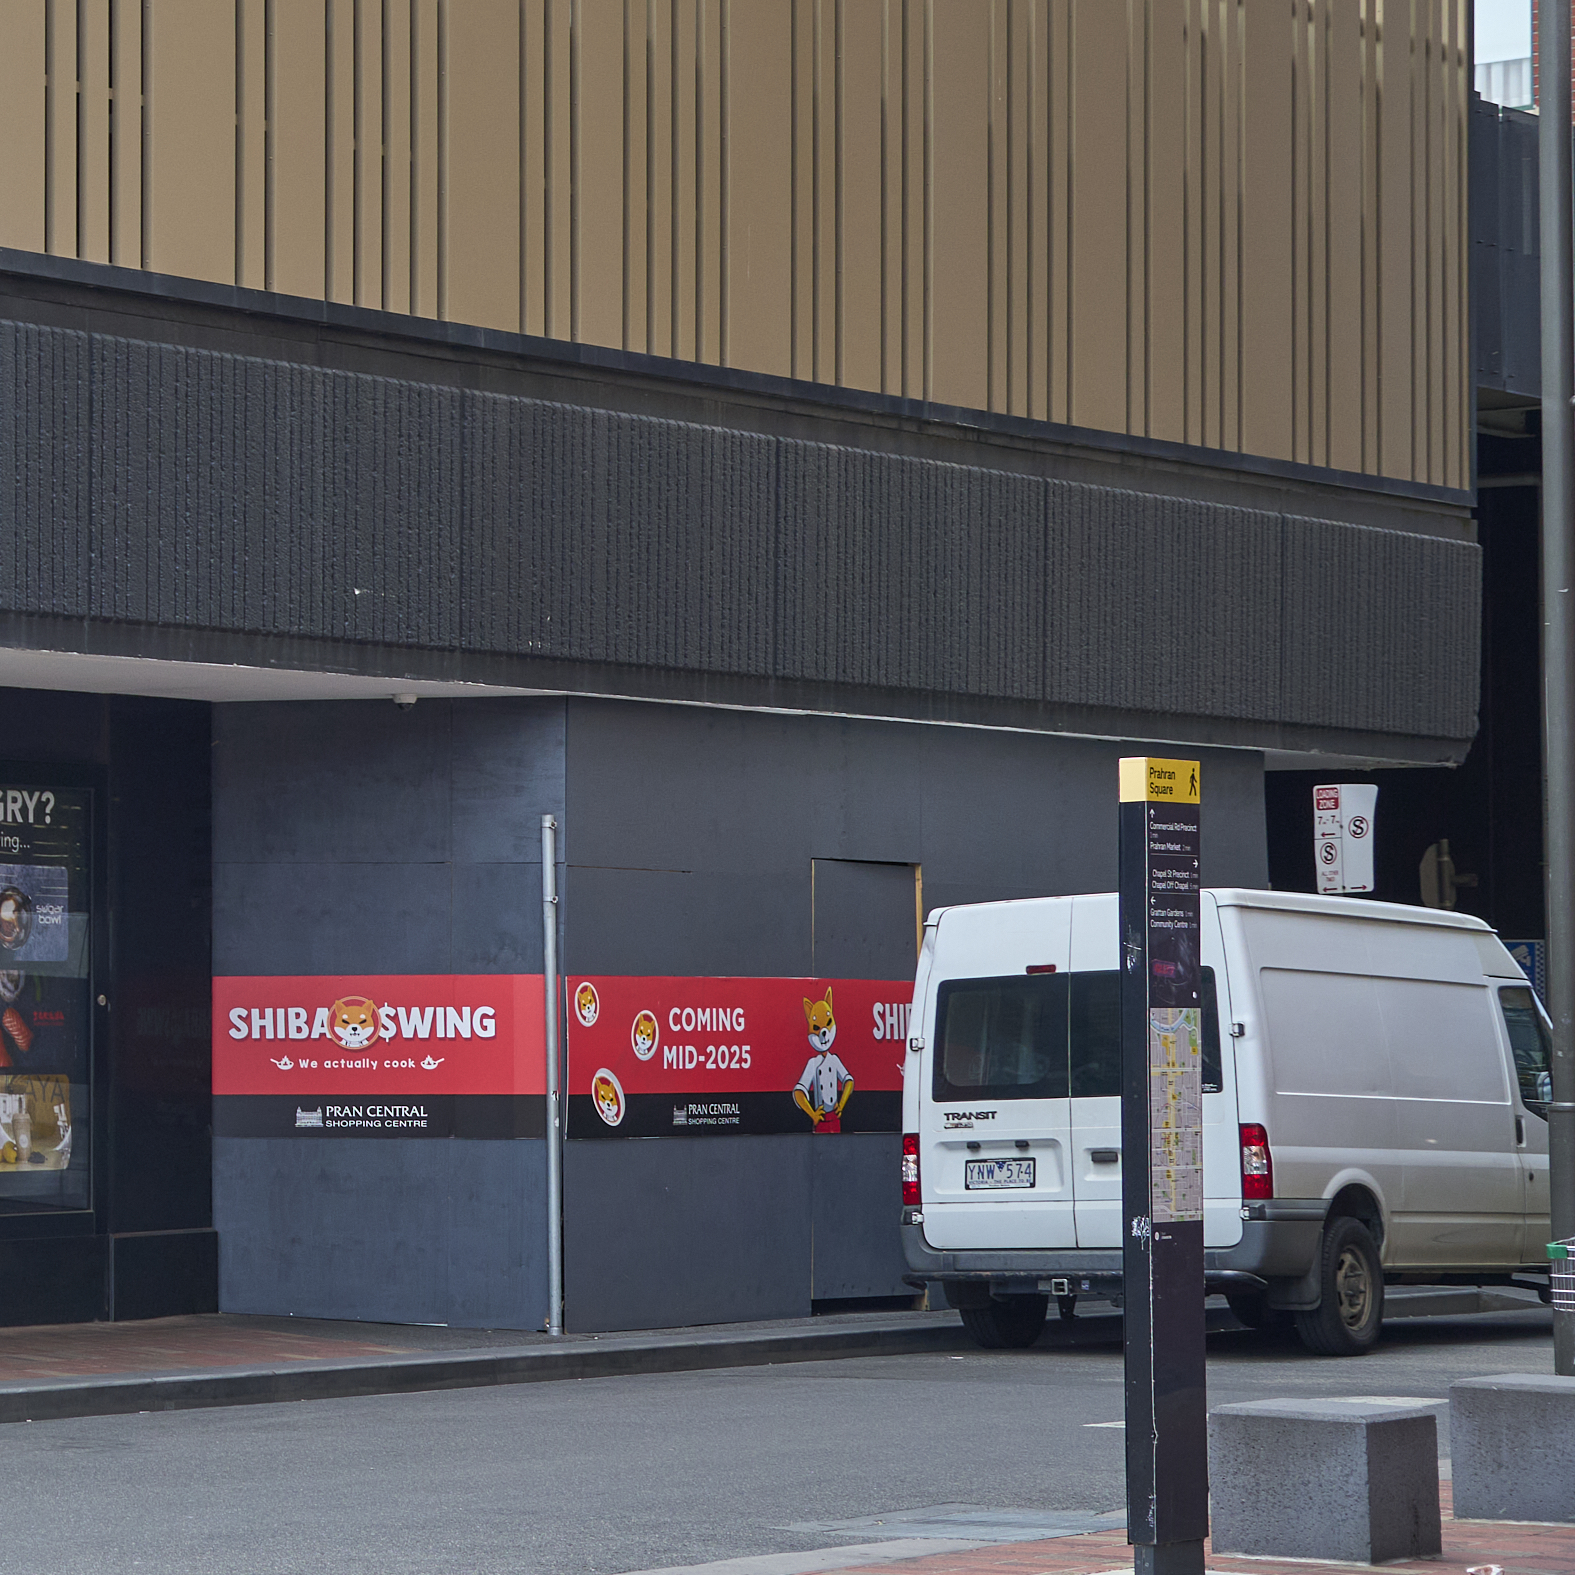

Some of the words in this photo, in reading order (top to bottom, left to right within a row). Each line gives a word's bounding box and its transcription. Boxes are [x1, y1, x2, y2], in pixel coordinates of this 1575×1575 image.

[1149, 767, 1176, 780] Prahran
[1149, 782, 1174, 796] Square
[1319, 799, 1336, 809] ZONE
[1150, 842, 1167, 850] Prahran
[1167, 842, 1181, 851] Market
[1152, 869, 1166, 879] Chapel
[1152, 880, 1166, 890] Chapel
[1174, 881, 1189, 891] Chapel
[36, 904, 64, 915] sugar
[1167, 908, 1184, 917] Gardens
[38, 914, 62, 924] bowl
[1150, 919, 1174, 930] Community
[229, 1007, 333, 1040] SHIBA
[669, 1007, 745, 1032] COMING
[663, 1045, 751, 1070] MID-2025
[298, 1058, 318, 1069] We
[324, 1058, 378, 1070] actually
[384, 1058, 416, 1069] cook
[326, 1105, 362, 1117] PRAN
[366, 1105, 428, 1117] CENTRAL
[688, 1103, 707, 1115] PRAN
[708, 1103, 740, 1114] CENTRAL
[688, 1117, 717, 1125] SHOPPING
[718, 1116, 740, 1124] CENTRE
[943, 1111, 997, 1121] TRANSIT
[325, 1120, 381, 1128] SHOPPING
[384, 1120, 428, 1128] CENTRE
[968, 1164, 996, 1180] YNW
